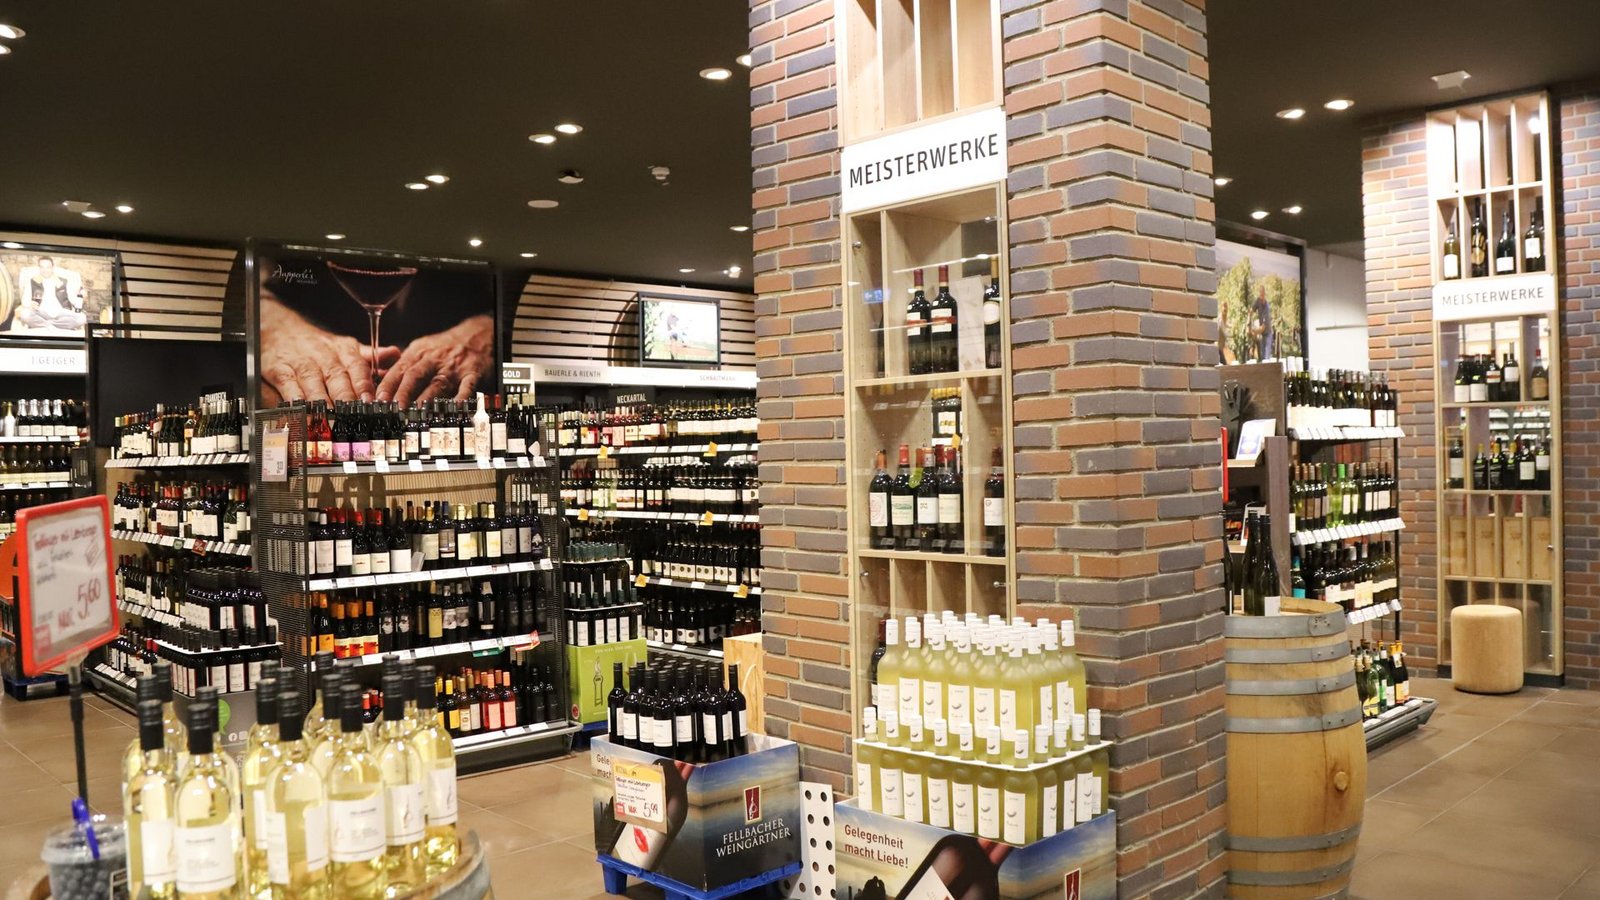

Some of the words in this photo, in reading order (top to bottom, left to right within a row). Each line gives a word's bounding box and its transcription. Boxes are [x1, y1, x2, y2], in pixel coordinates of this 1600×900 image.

[849, 133, 999, 189] MEISTERWERKE
[1442, 286, 1545, 306] MEISTERWERKE
[503, 370, 521, 378] GOLD
[616, 393, 647, 405] NECKARTAL
[715, 827, 792, 858] WEINGÄRTNER
[723, 818, 785, 846] FELLBACHER
[844, 824, 904, 850] Gelegenheit
[844, 841, 875, 860] macht
[876, 848, 909, 869] Liebe!
